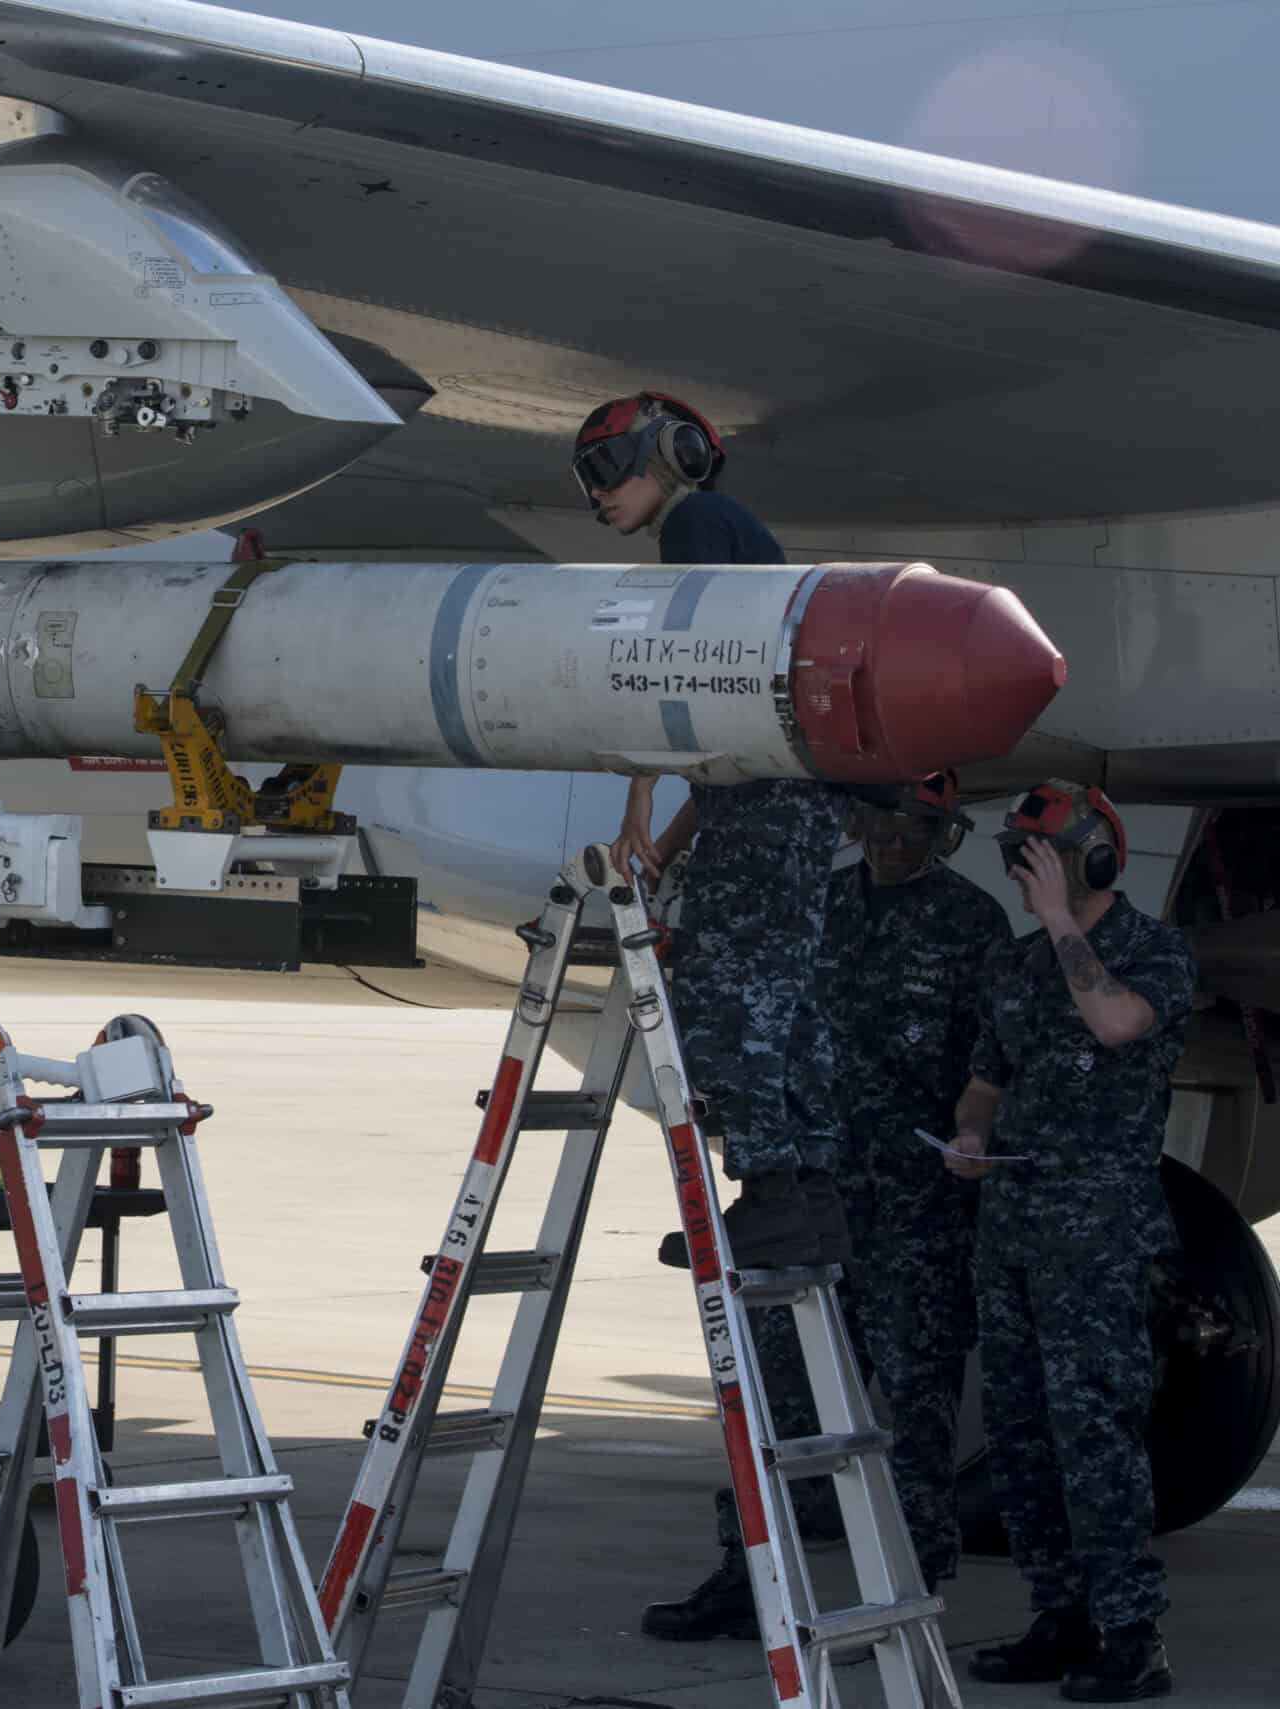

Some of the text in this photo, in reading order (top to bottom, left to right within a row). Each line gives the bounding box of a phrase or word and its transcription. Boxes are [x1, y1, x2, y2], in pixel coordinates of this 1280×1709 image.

[609, 637, 767, 665] CATM-84D-1
[610, 672, 762, 695] 543-174-0350
[704, 1295, 730, 1342] 310
[379, 1408, 407, 1444] P8
